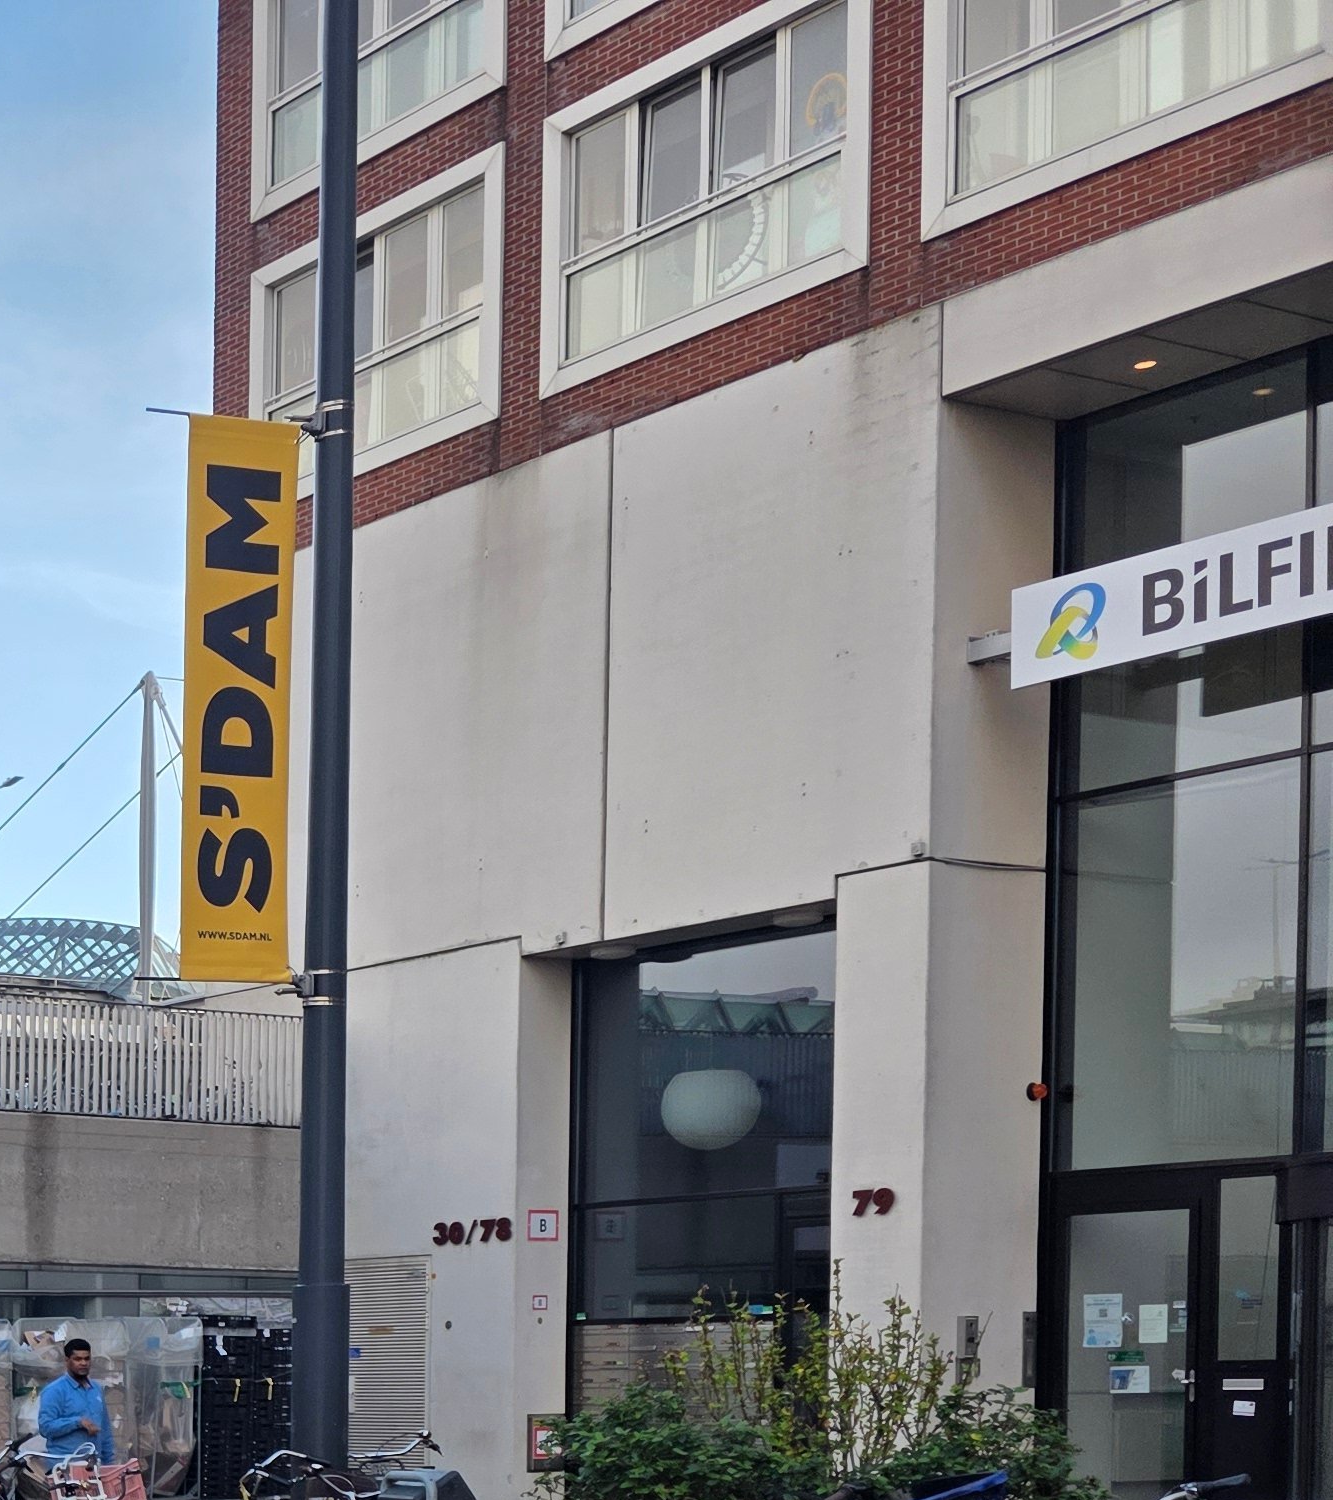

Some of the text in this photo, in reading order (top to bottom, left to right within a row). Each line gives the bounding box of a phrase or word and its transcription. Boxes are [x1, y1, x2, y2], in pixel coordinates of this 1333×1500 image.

[197, 464, 281, 913] S'DAM
[197, 930, 272, 942] WWW.SDAM.NL
[852, 1188, 895, 1216] 79
[432, 1217, 513, 1246] 30/78
[539, 1219, 547, 1232] B
